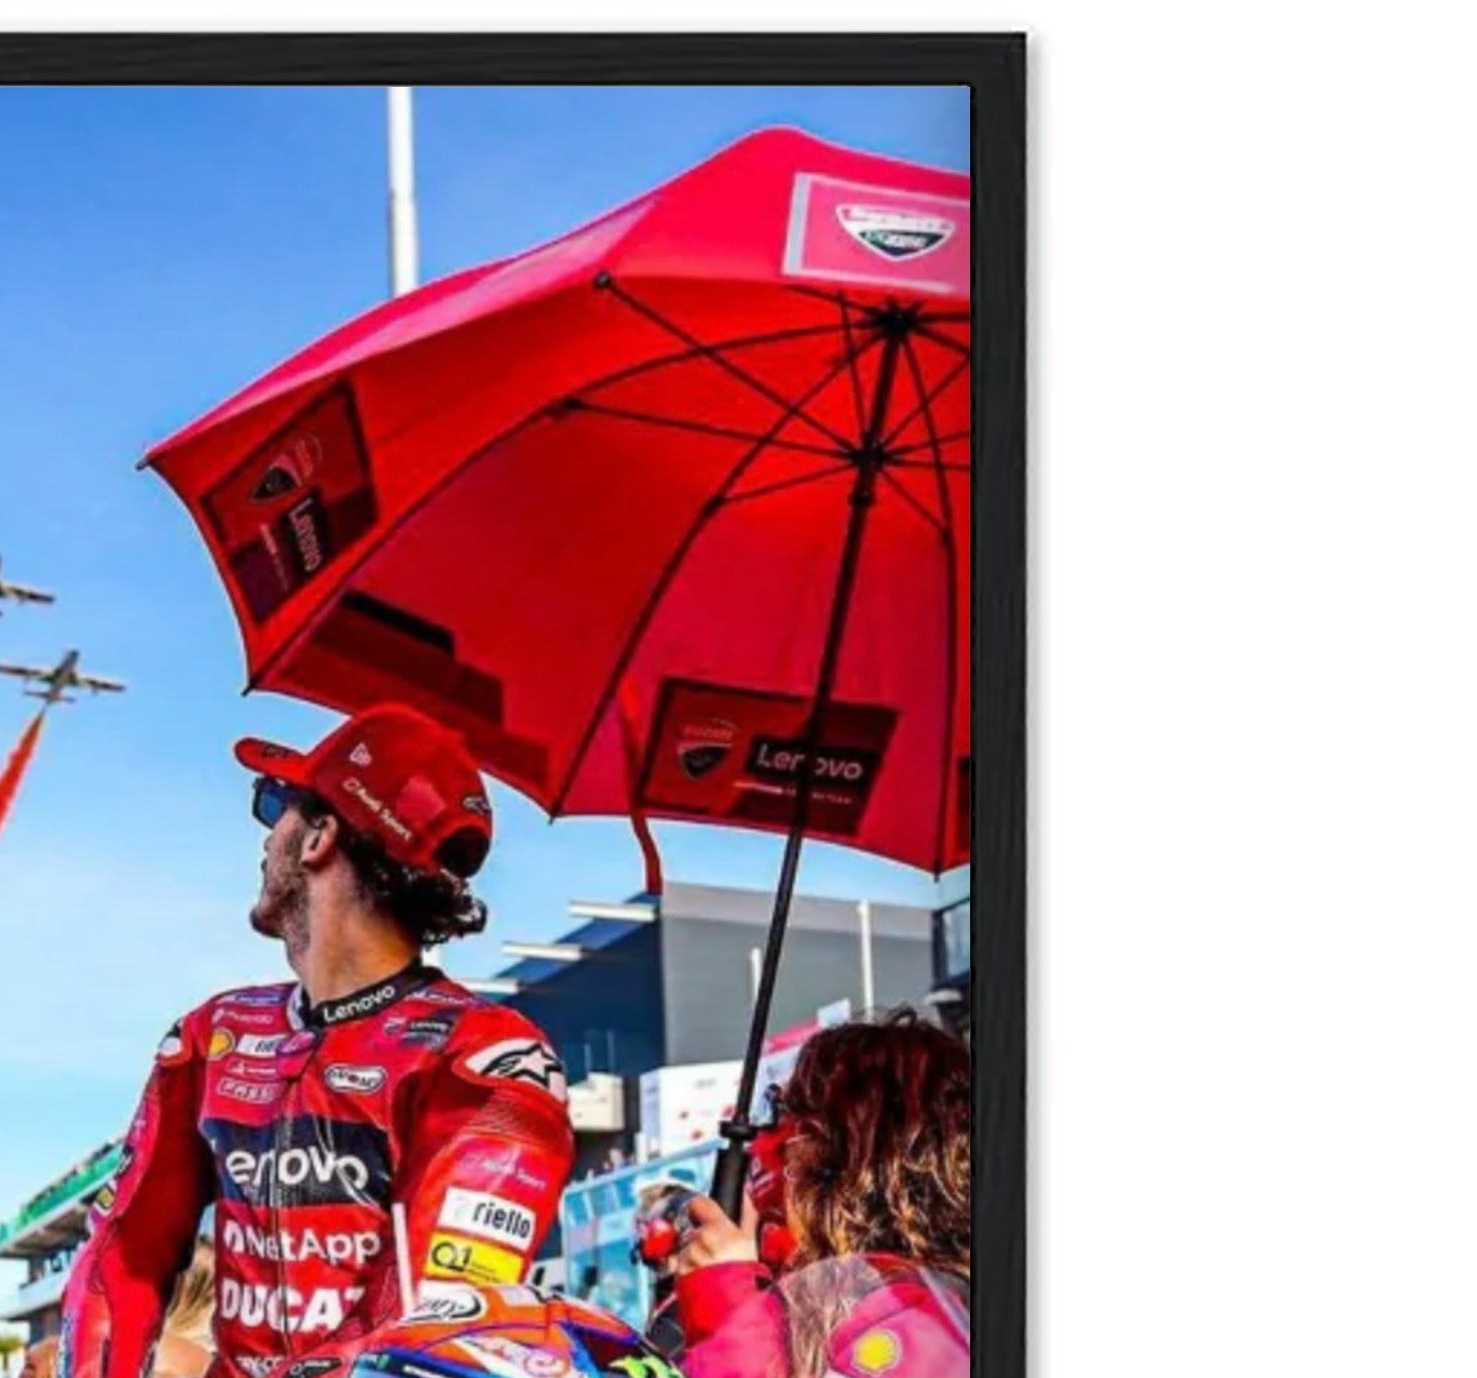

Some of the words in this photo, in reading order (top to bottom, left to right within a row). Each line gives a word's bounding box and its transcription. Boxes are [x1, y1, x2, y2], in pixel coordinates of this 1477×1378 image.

[324, 985, 396, 1022] Lenovo
[224, 1146, 370, 1190] enovo
[472, 1201, 532, 1239] riello
[220, 1276, 366, 1333] DUCA
